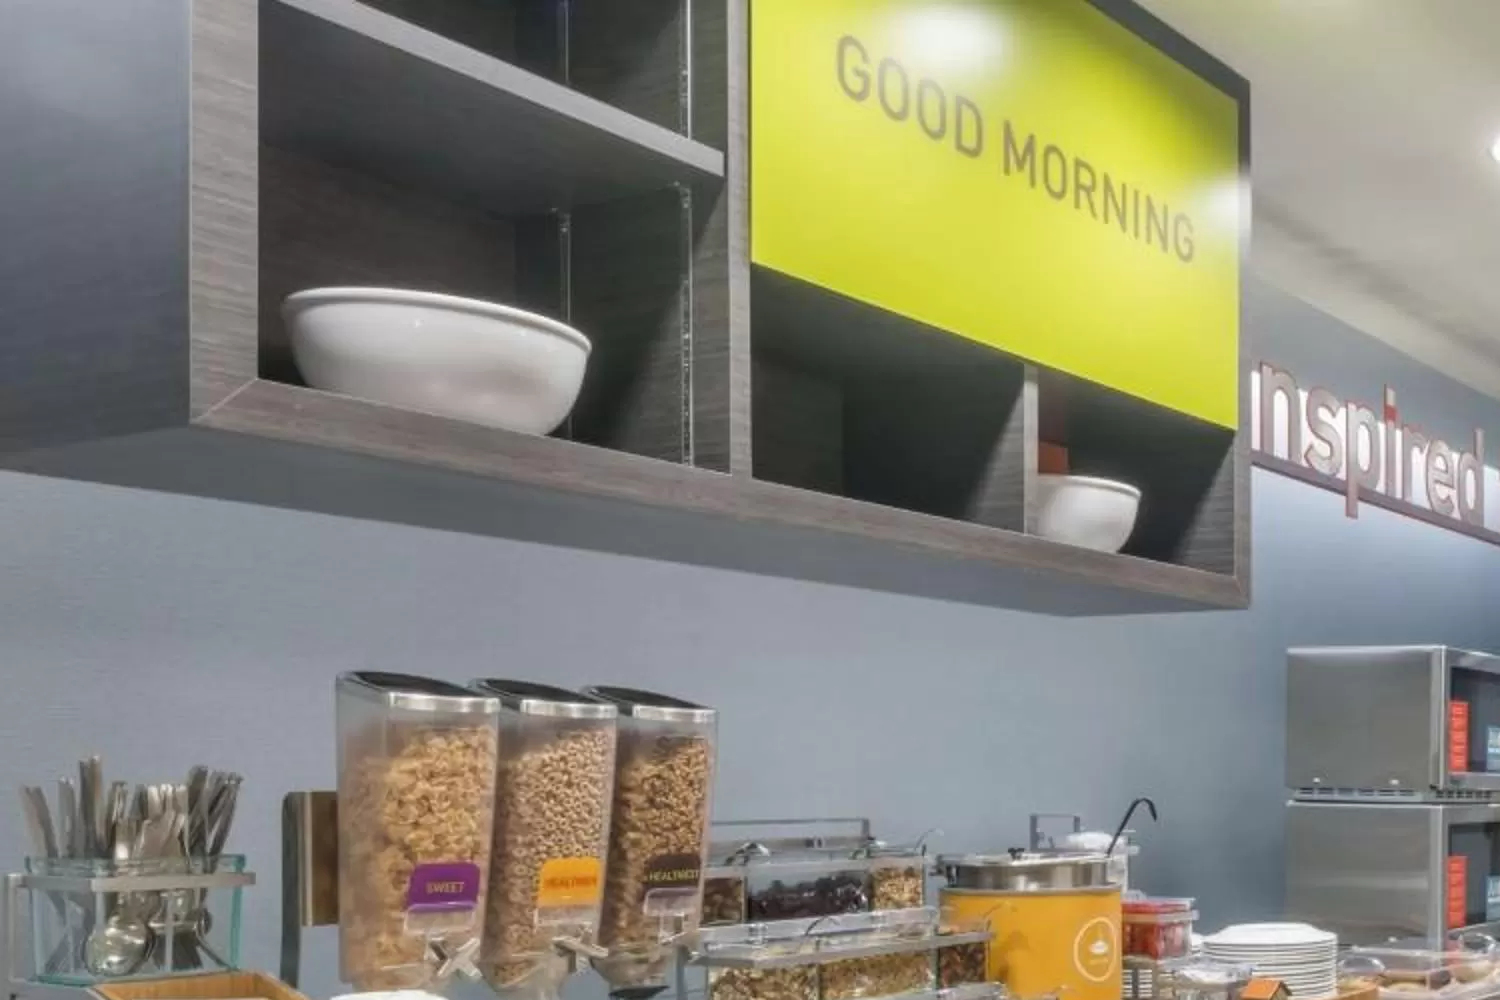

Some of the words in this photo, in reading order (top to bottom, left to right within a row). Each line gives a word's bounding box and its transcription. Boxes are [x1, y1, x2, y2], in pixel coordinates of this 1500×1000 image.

[836, 36, 984, 159] GOOD
[1002, 120, 1195, 263] MORNING
[1260, 361, 1485, 519] nspired
[426, 881, 465, 894] SWEET
